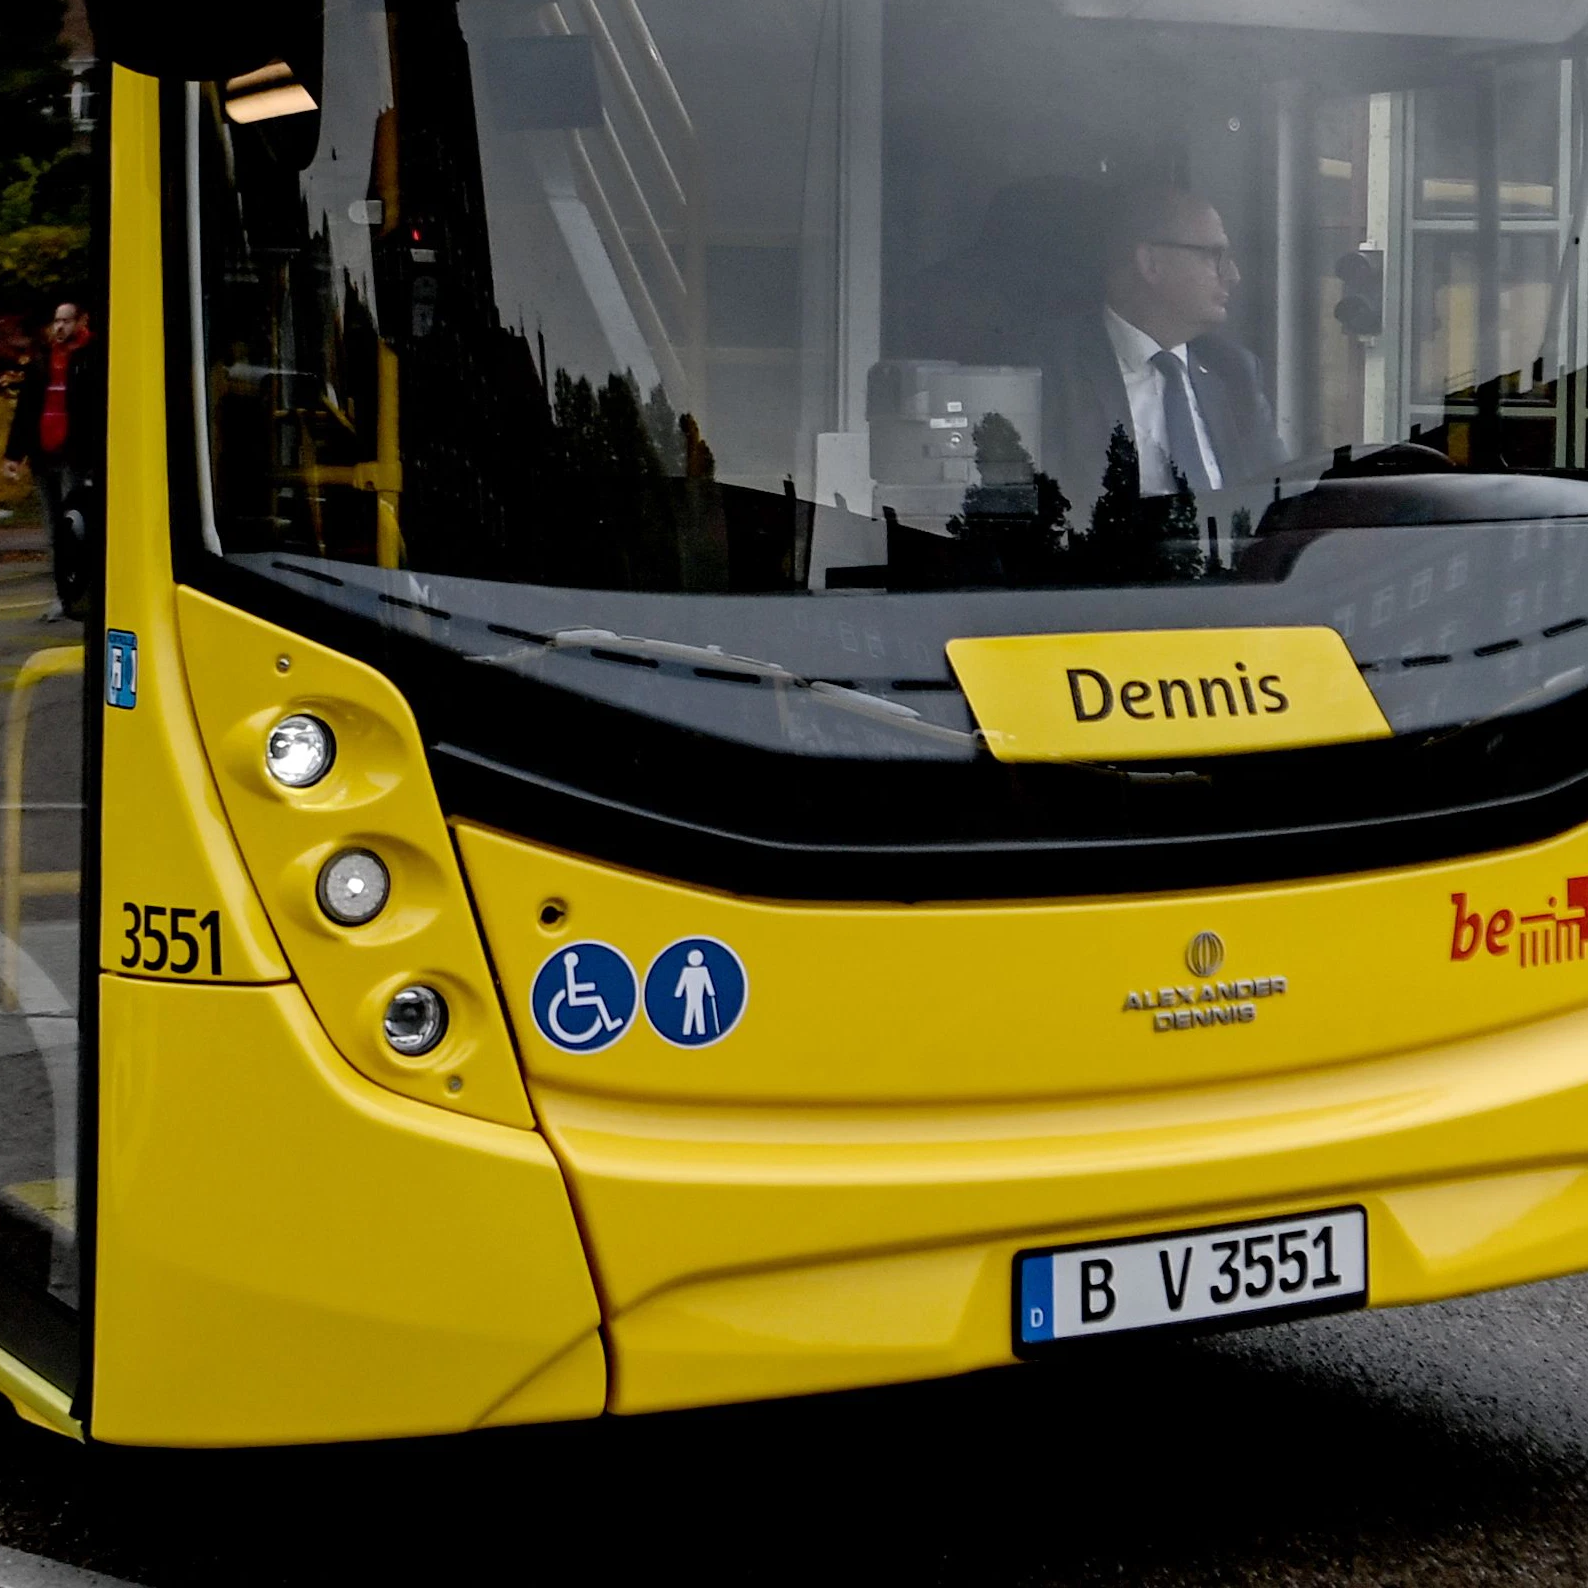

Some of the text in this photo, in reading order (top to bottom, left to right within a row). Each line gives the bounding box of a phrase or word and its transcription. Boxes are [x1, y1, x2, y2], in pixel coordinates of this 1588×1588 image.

[1065, 660, 1290, 724] Dennis
[120, 901, 223, 976] 3551
[1122, 975, 1288, 1013] ALEXANDER
[1153, 1003, 1257, 1034] DENNIS
[1029, 1225, 1342, 1329] D B V 3551
